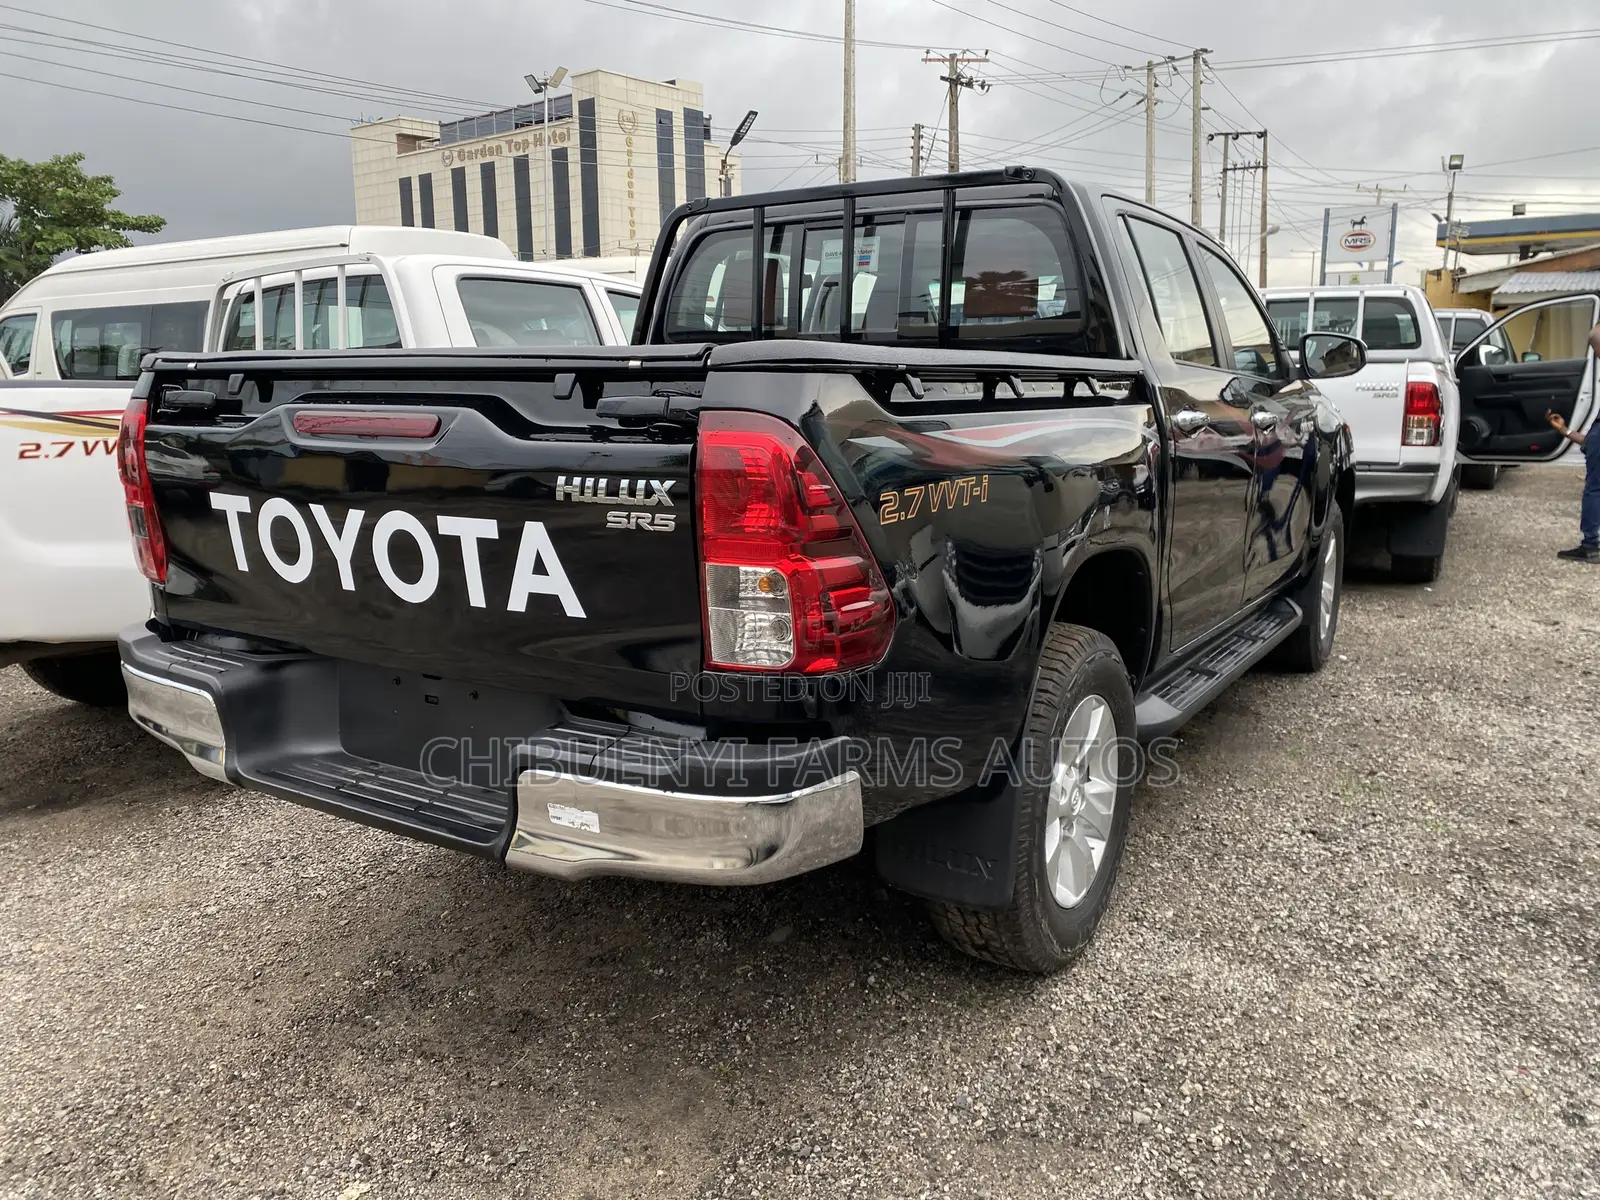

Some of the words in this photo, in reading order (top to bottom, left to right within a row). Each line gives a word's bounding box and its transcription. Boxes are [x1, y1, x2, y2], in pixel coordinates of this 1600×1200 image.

[457, 143, 503, 162] Garden
[506, 139, 529, 153] Top
[1344, 237, 1371, 245] MRS
[18, 440, 75, 460] 2.7
[556, 475, 676, 507] HILUX
[880, 485, 925, 525] 2.7
[928, 474, 989, 513] VVT-i
[606, 510, 677, 532] SR5
[208, 491, 587, 618] TOYOTA
